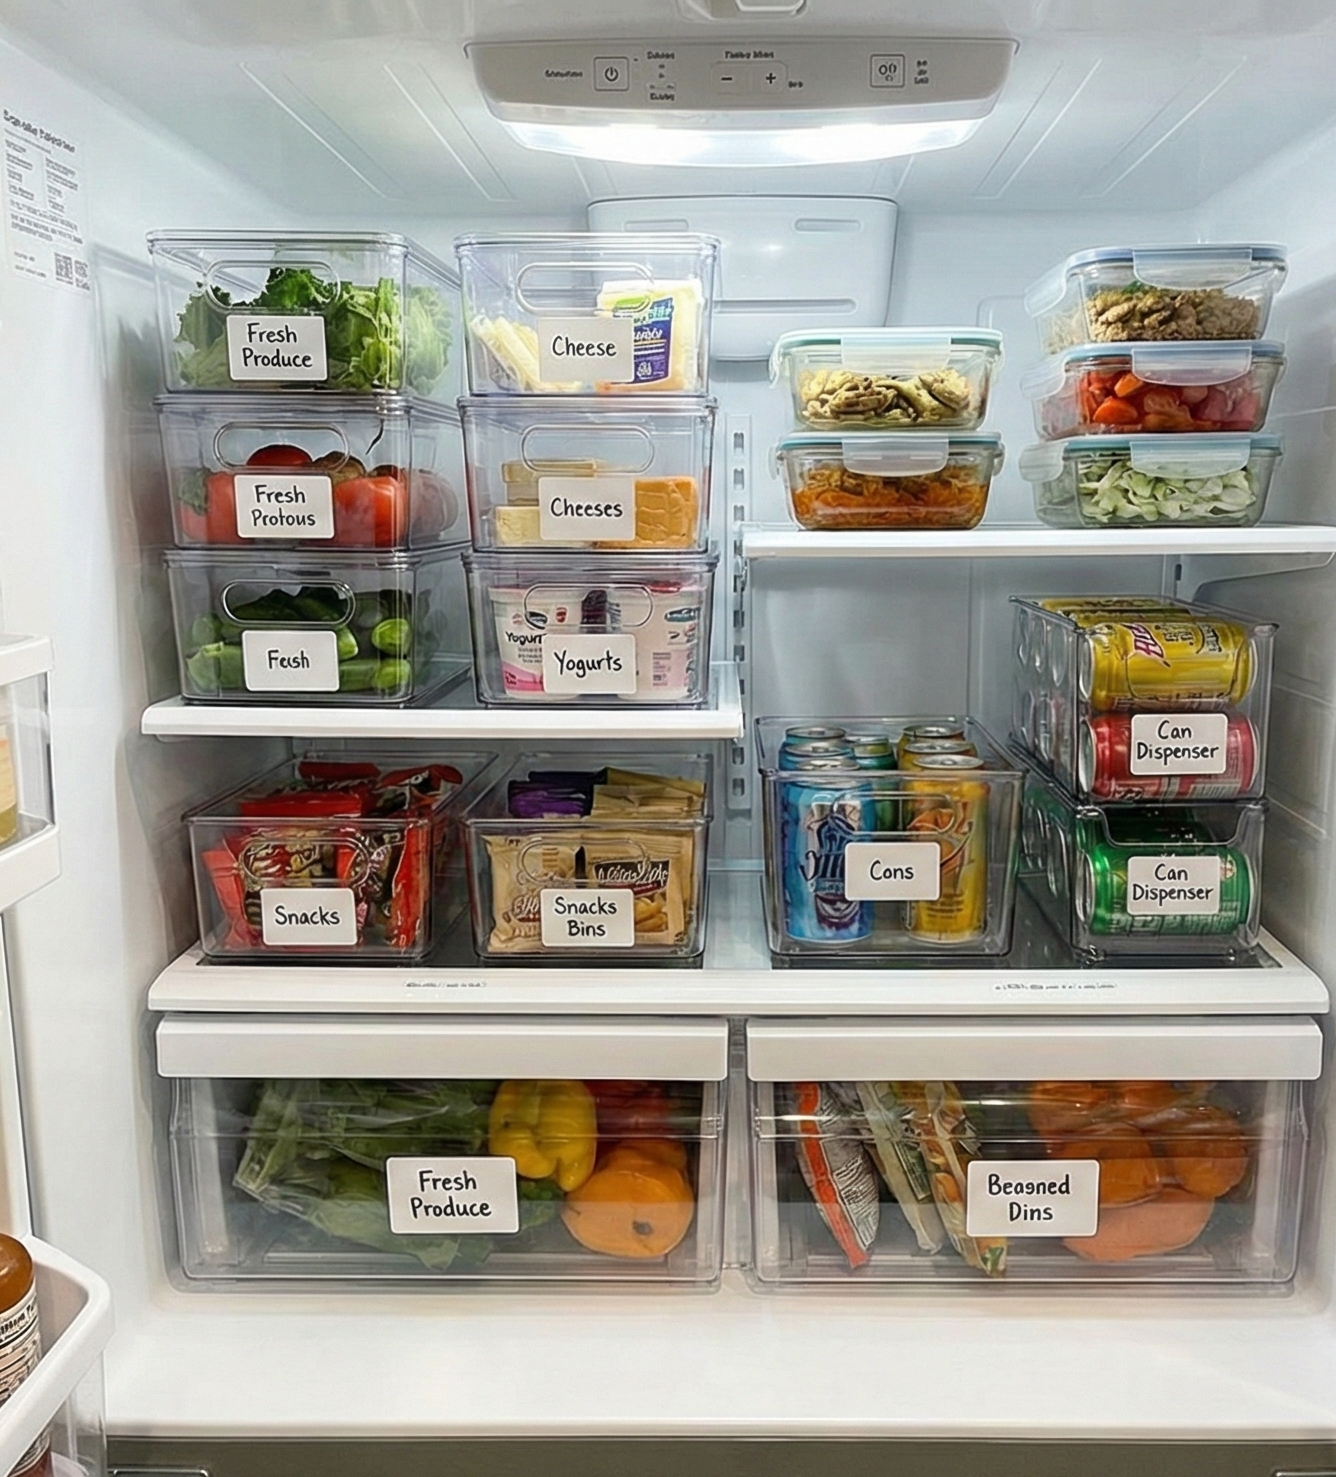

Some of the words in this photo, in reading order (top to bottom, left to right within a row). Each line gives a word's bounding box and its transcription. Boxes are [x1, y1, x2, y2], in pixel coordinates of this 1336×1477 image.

[247, 322, 297, 344] Fresh
[552, 335, 617, 357] Cheese
[242, 347, 313, 368] Produce
[254, 484, 306, 504] Fresh
[251, 507, 316, 527] Protous
[550, 497, 623, 518] Cheeses
[553, 649, 623, 679] Yogurts
[1157, 719, 1192, 740] Can
[1136, 742, 1220, 767] Dispenser
[870, 859, 914, 881] Cons
[1154, 863, 1188, 881] Can
[554, 896, 617, 915] Snacks
[1132, 883, 1214, 907] Dispenser
[274, 905, 340, 926] Snacks
[567, 919, 606, 937] Bins
[419, 1169, 477, 1192] Fresh
[410, 1195, 492, 1219] Produce
[1009, 1201, 1053, 1222] Dins
